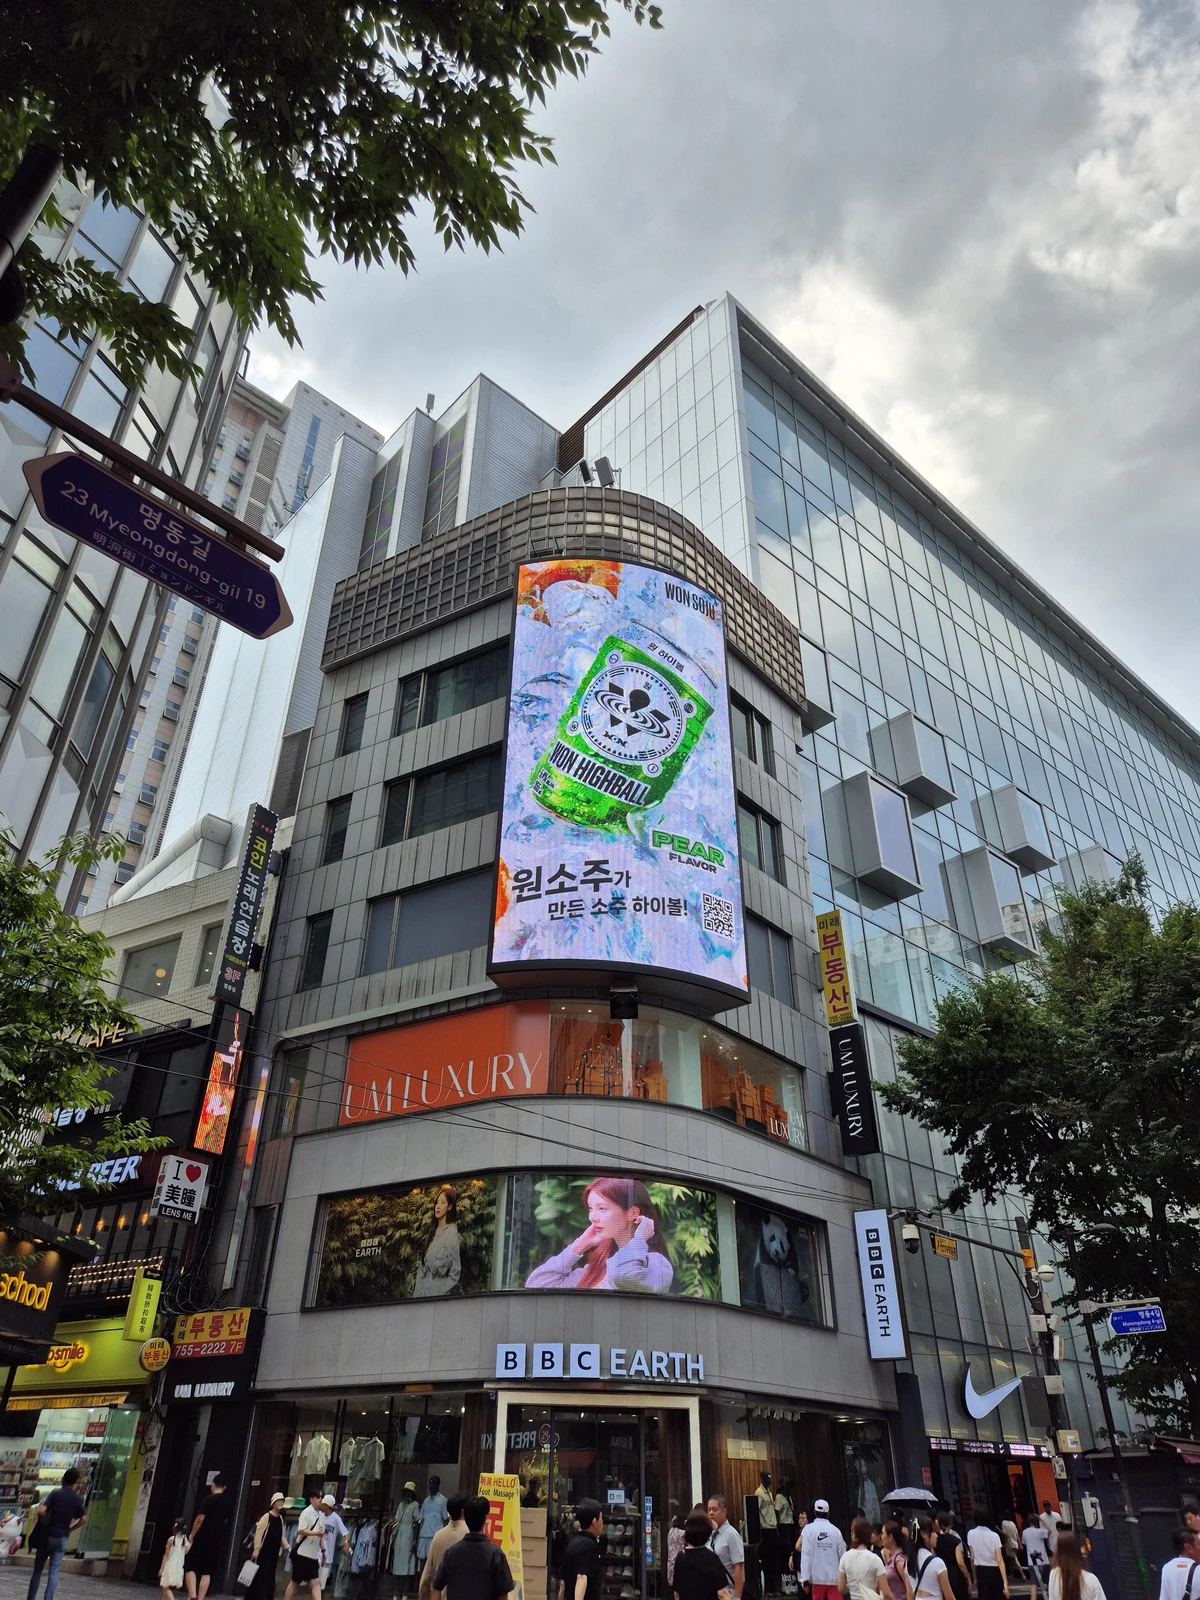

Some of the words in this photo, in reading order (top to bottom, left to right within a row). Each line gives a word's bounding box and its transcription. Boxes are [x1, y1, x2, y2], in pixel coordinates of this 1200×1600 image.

[60, 480, 90, 507] 23
[89, 504, 241, 601] Myeongdong-gil
[246, 587, 267, 610] 19
[92, 531, 137, 563] 明洞街
[138, 502, 213, 563] 명동길
[148, 563, 226, 613] ミョンドンギル
[665, 582, 690, 607] WON
[692, 593, 715, 619] SOJU
[648, 642, 658, 652] 원
[658, 651, 686, 672] 하이볼
[549, 741, 579, 773] WON
[573, 757, 648, 806] HIGHBALL
[651, 830, 725, 867] PEAR
[669, 853, 718, 874] FLAVOR
[548, 898, 586, 921] 만든
[591, 897, 628, 917] 소주
[633, 896, 688, 917] 하이볼!
[819, 915, 841, 930] 미래
[224, 967, 241, 982] 3F
[821, 932, 851, 1013] 부동산
[838, 1038, 854, 1067] UM
[346, 1077, 393, 1119] UM
[403, 1052, 543, 1109] LUXURY
[788, 1108, 805, 1129] UM
[842, 1071, 864, 1140] LUXURY
[770, 1117, 806, 1147] LUXURY
[173, 1160, 184, 1181] I
[164, 1184, 197, 1208] 美瞳
[162, 1206, 181, 1218] LENS
[182, 1212, 193, 1221] ME
[356, 1247, 382, 1258] EARTH
[866, 1228, 885, 1279] BBC
[874, 1284, 891, 1338] EARTH
[178, 1318, 188, 1341] 미래
[190, 1312, 245, 1340] 부동산
[143, 1350, 169, 1361] 부동산
[150, 1341, 165, 1349] 미래
[175, 1341, 225, 1357] 755-2222
[229, 1341, 243, 1354] 7F
[500, 1347, 596, 1374] BBC
[610, 1348, 704, 1380] EARTH
[194, 1382, 235, 1397] LUXURY
[739, 1450, 757, 1458] EARTH
[479, 1487, 490, 1496] Foot
[493, 1488, 514, 1500] Massage
[493, 1478, 515, 1488] HELLO
